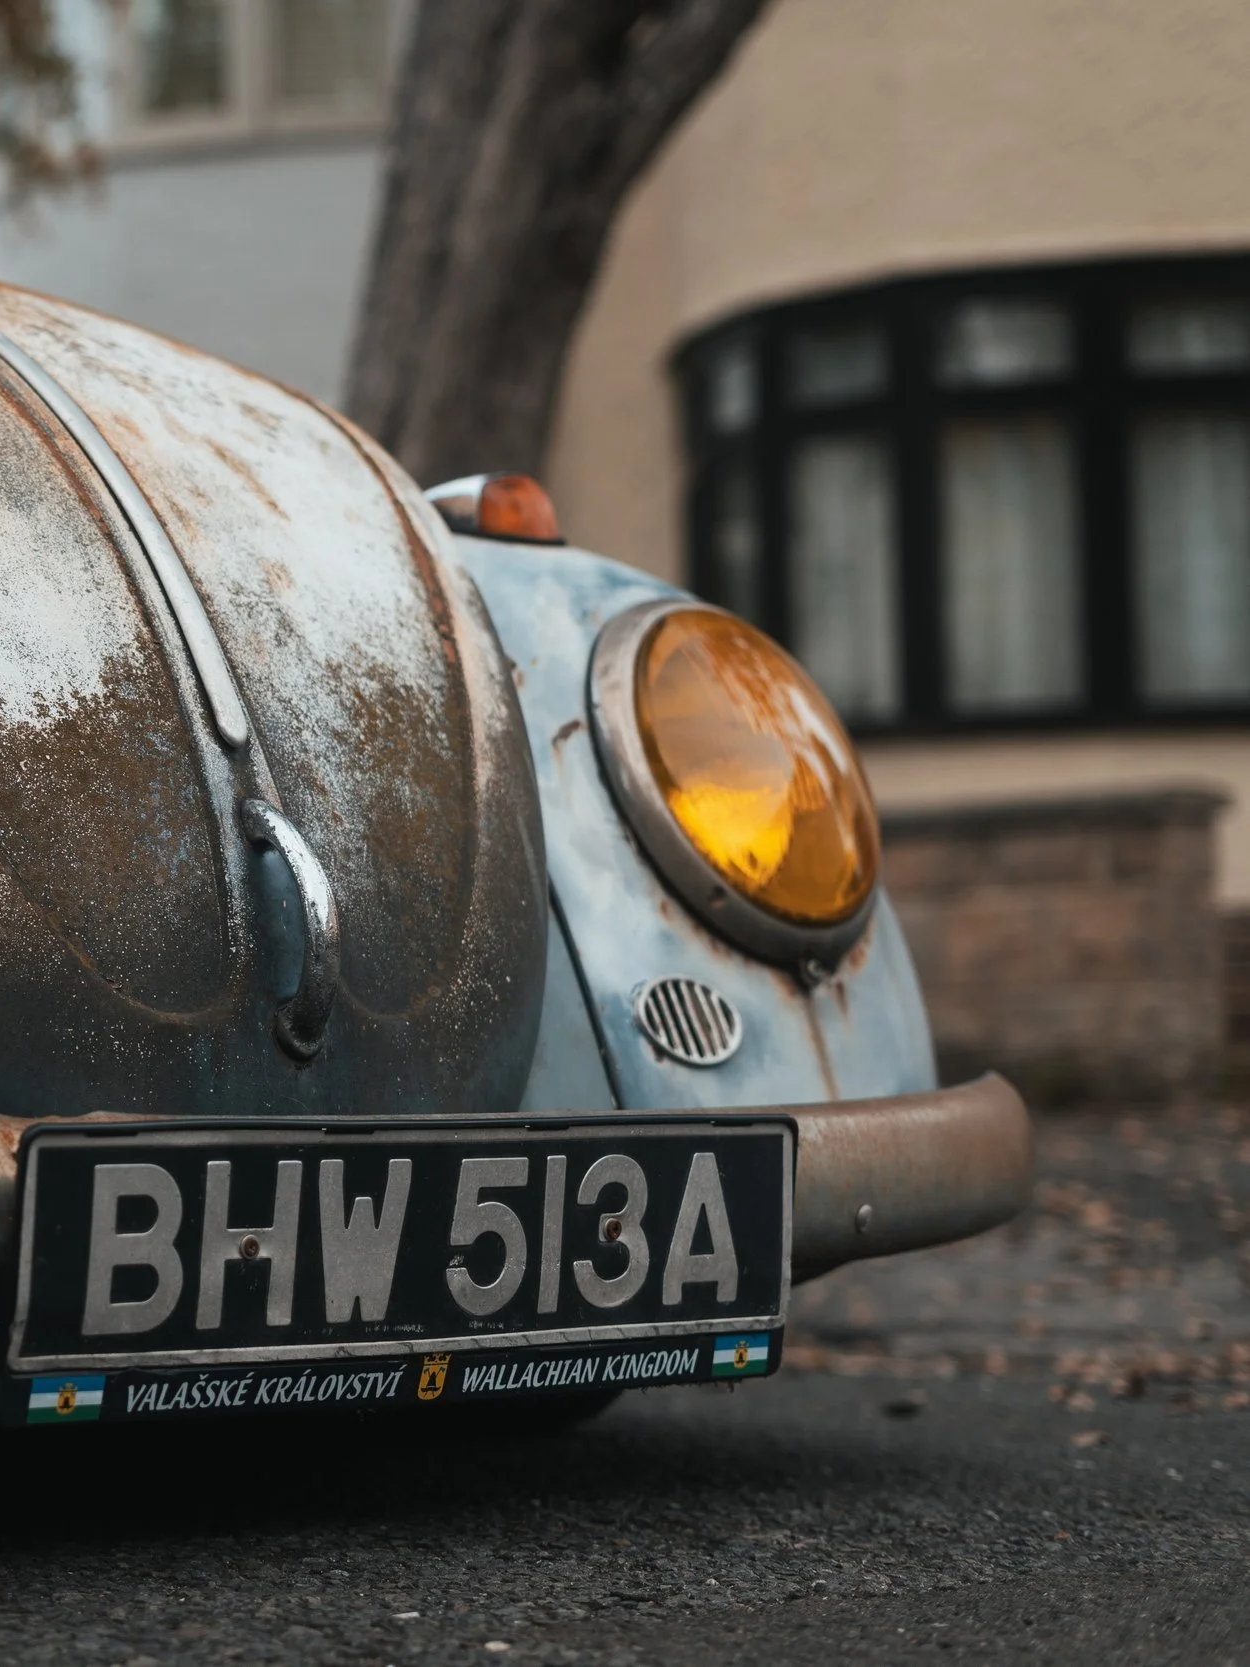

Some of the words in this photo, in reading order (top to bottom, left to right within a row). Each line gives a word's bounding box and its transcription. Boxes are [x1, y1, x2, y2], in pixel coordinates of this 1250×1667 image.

[81, 1158, 414, 1337] BHW
[445, 1152, 739, 1317] 513A
[125, 1372, 254, 1413] VALAŠSKÉ
[254, 1365, 407, 1405] KRÁLOVSTVÍ
[461, 1356, 601, 1393] WALLACHIAN
[602, 1348, 699, 1382] KINGDOM
